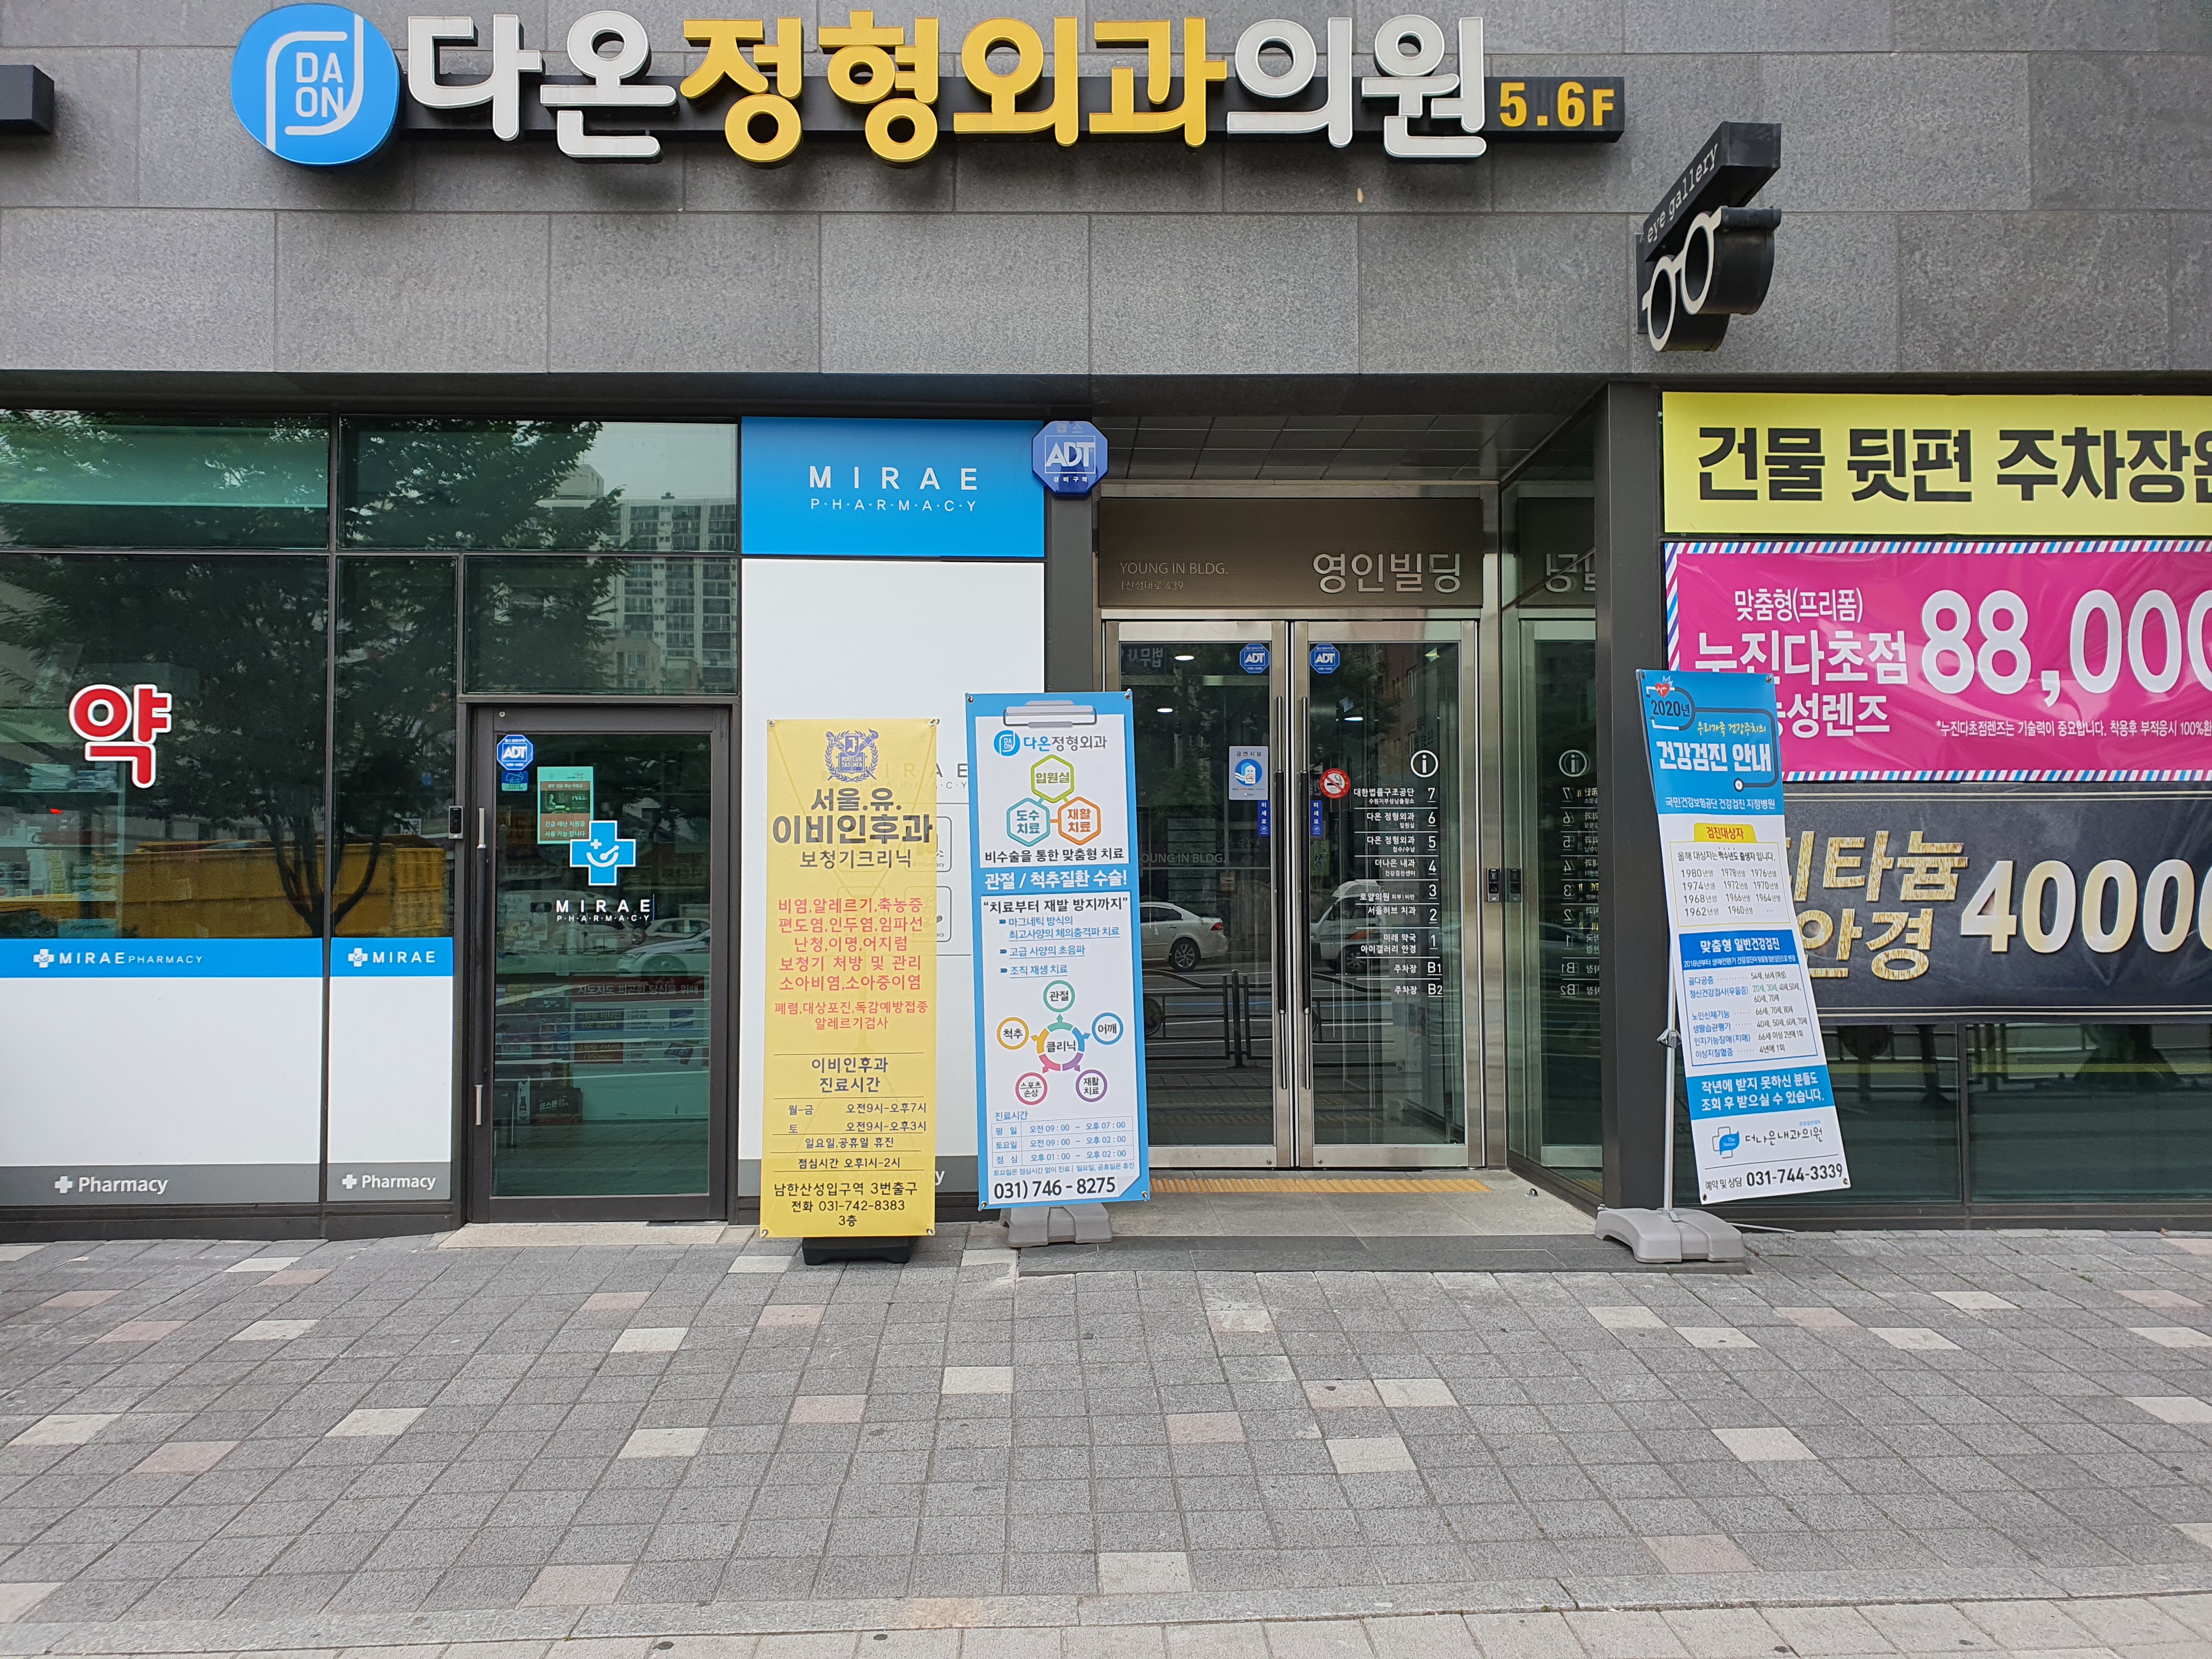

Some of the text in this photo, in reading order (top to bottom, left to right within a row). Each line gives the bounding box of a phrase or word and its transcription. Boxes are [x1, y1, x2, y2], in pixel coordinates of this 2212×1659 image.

[295, 52, 343, 84] DA
[295, 86, 345, 120] ON
[1498, 81, 1615, 128] 5.6F
[1647, 143, 1718, 243] eye gallery
[1057, 423, 1083, 433] 캡스
[1046, 442, 1095, 467] ADT
[1698, 427, 1826, 502] 건물
[1848, 428, 1973, 503] 뒷편
[809, 466, 977, 490] MIRAE
[1120, 562, 1228, 574] YOUNG IN BLDG.
[1313, 552, 1462, 594] 영인빌딩
[1165, 581, 1183, 590] 439
[1734, 587, 1863, 623] 맞춤형(프리폼)
[1245, 652, 1335, 664] ADT ADT
[1695, 630, 1909, 685] 누진다초점
[1651, 699, 1690, 717] 2020년
[2017, 720, 2055, 737] 기술력이
[2057, 719, 2107, 737] 중요합니다.
[2110, 720, 2137, 737] 착용후
[2140, 720, 2177, 737] 부적응시
[68, 684, 172, 788] 약
[1023, 735, 1108, 752] 다온정형외과
[503, 746, 527, 759] ADT
[1656, 741, 1772, 772] 건강검진 안내
[1035, 772, 1070, 784] 입원실
[1353, 788, 1415, 797] 대한법률구조공단
[1665, 797, 1746, 810] 국민건강보험공단 건강검진
[1016, 810, 1040, 821] 도수
[1068, 808, 1091, 820] 재활
[1367, 812, 1436, 824] 다온 정형외과 6
[772, 814, 933, 844] 이비인후과
[1017, 823, 1040, 834] 치료
[1068, 821, 1091, 833] 치료
[1706, 826, 1744, 840] 검진대상자
[1367, 836, 1436, 849] 다온 정형외과 5
[799, 848, 912, 869] 보청기크리닉
[985, 847, 1124, 864] 비수술을 통한 맞춤형 치료
[1375, 859, 1437, 873] 더나은 내과 4
[1680, 868, 1714, 878] 1980년생
[985, 868, 1128, 890] 관절 척추질환 수술!
[1682, 881, 1716, 891] 1974년생
[778, 896, 923, 915] 비염,알레르기,축농증
[1043, 898, 1069, 912] 재발
[1683, 893, 1751, 904] 1968년생 1966년생
[556, 899, 651, 913] MIRAE
[1368, 906, 1416, 915] 서울허브 치과
[1684, 906, 1753, 917] 1962년생 1960년생
[1960, 859, 2212, 953] 4000
[1008, 915, 1074, 927] 마그네틱 방식의
[1009, 926, 1120, 940] 최고사양의 치료
[1384, 933, 1417, 942] 미래 약국
[1009, 944, 1086, 957] 고급 사양의 초음파
[1361, 945, 1416, 953] 아이갤러리 안경
[1700, 937, 1781, 953] 맞춤형 일반건강검진
[1797, 908, 1934, 980] 안경
[59, 952, 204, 964] MIRAE PHARMACY
[373, 951, 437, 963] MIRAE
[779, 954, 922, 973] 보청기 처방 및 관리
[1010, 964, 1069, 975] 조직 재생 치료
[1393, 961, 1442, 974] 주차장 B1
[1688, 975, 1714, 985] 골다공증
[1049, 990, 1069, 1002] 관절
[1394, 983, 1443, 995] 주차장 B2
[815, 1016, 889, 1031] 알레르기검사
[1098, 1023, 1118, 1035] 어깨
[1003, 1028, 1024, 1040] 척추
[1046, 1040, 1076, 1053] 클리닉
[811, 1057, 889, 1074] 이비인후과
[819, 1076, 881, 1093] 진료시간
[1701, 1071, 1819, 1094] 작년에 받지 못하신 분들도
[1084, 1086, 1100, 1096] 치료
[1701, 1088, 1825, 1111] 조회 후 받으실 수 있습니다.
[995, 1110, 1029, 1121] 진료시간
[873, 1136, 895, 1148] 휴진
[1745, 1126, 1823, 1146] 더나은내과의원
[798, 1158, 839, 1170] 점심시간
[362, 1173, 437, 1191] Pharmacy
[1746, 1163, 1843, 1187] 031-744-3339
[78, 1176, 168, 1196] Pharmacy
[774, 1181, 918, 1197] 남한산성입구역 3번출구
[1032, 1176, 1116, 1198] 746 8275
[791, 1199, 906, 1213] 전화 031-742-8383
[838, 1214, 858, 1227] 3층
